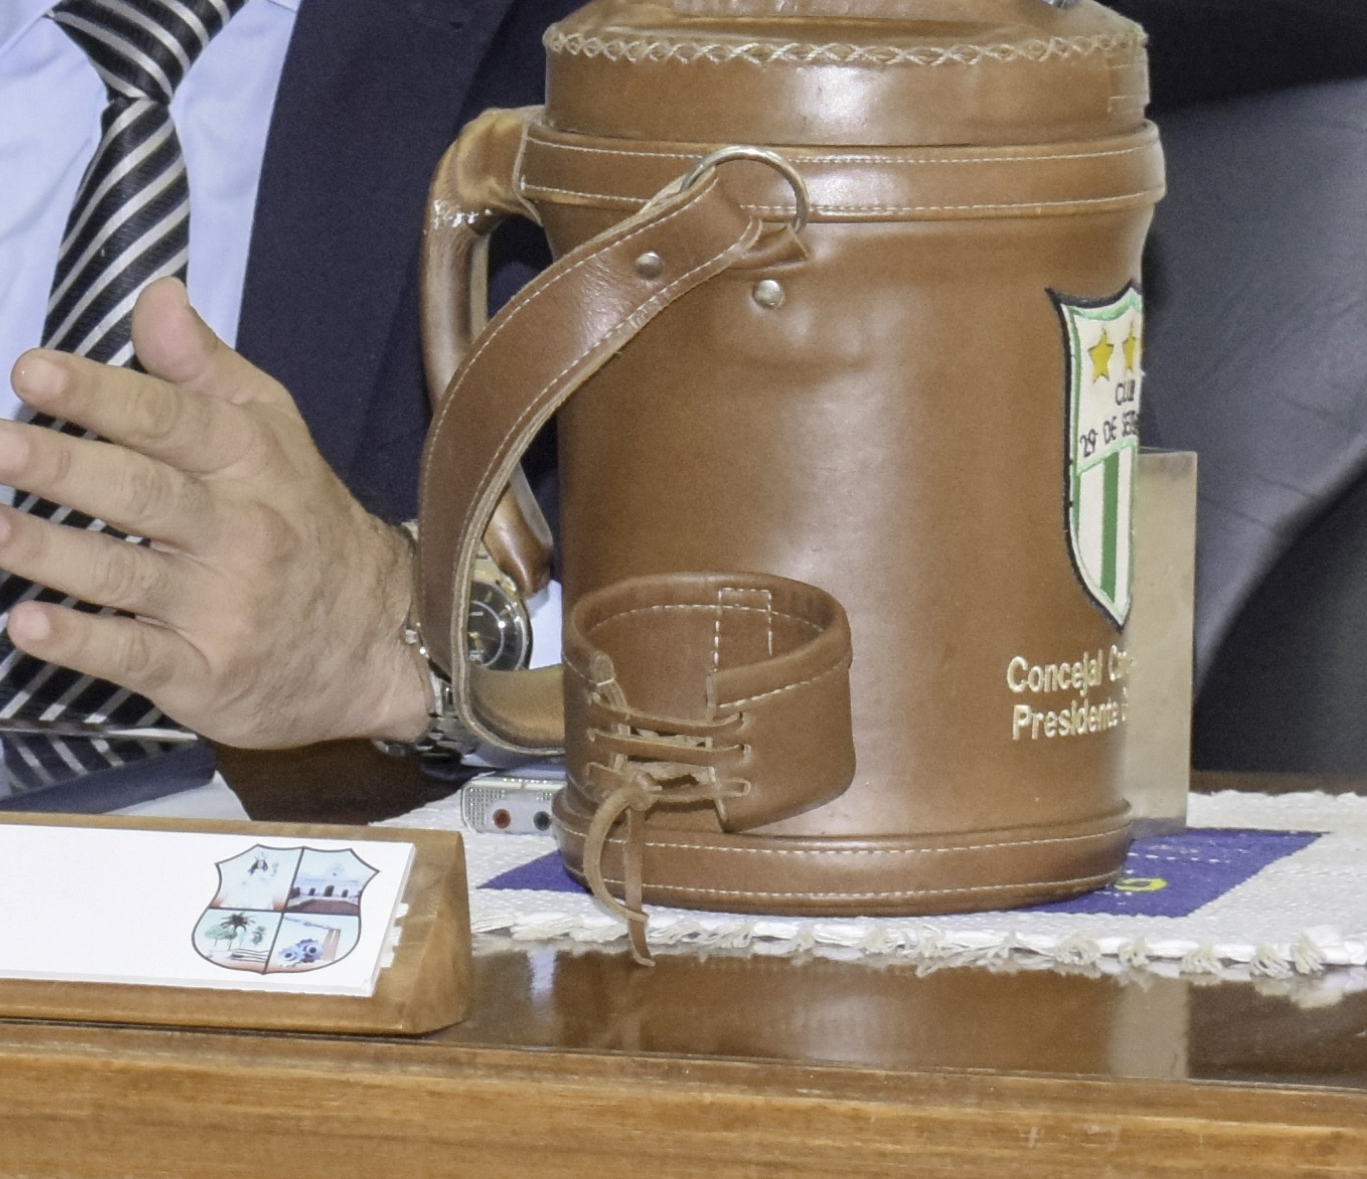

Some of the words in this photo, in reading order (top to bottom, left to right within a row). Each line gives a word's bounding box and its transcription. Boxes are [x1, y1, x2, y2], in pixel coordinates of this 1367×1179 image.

[1079, 428, 1099, 457] 29
[1103, 416, 1118, 445] DE
[1006, 649, 1104, 697] Concejal
[1012, 697, 1120, 741] Presidente
